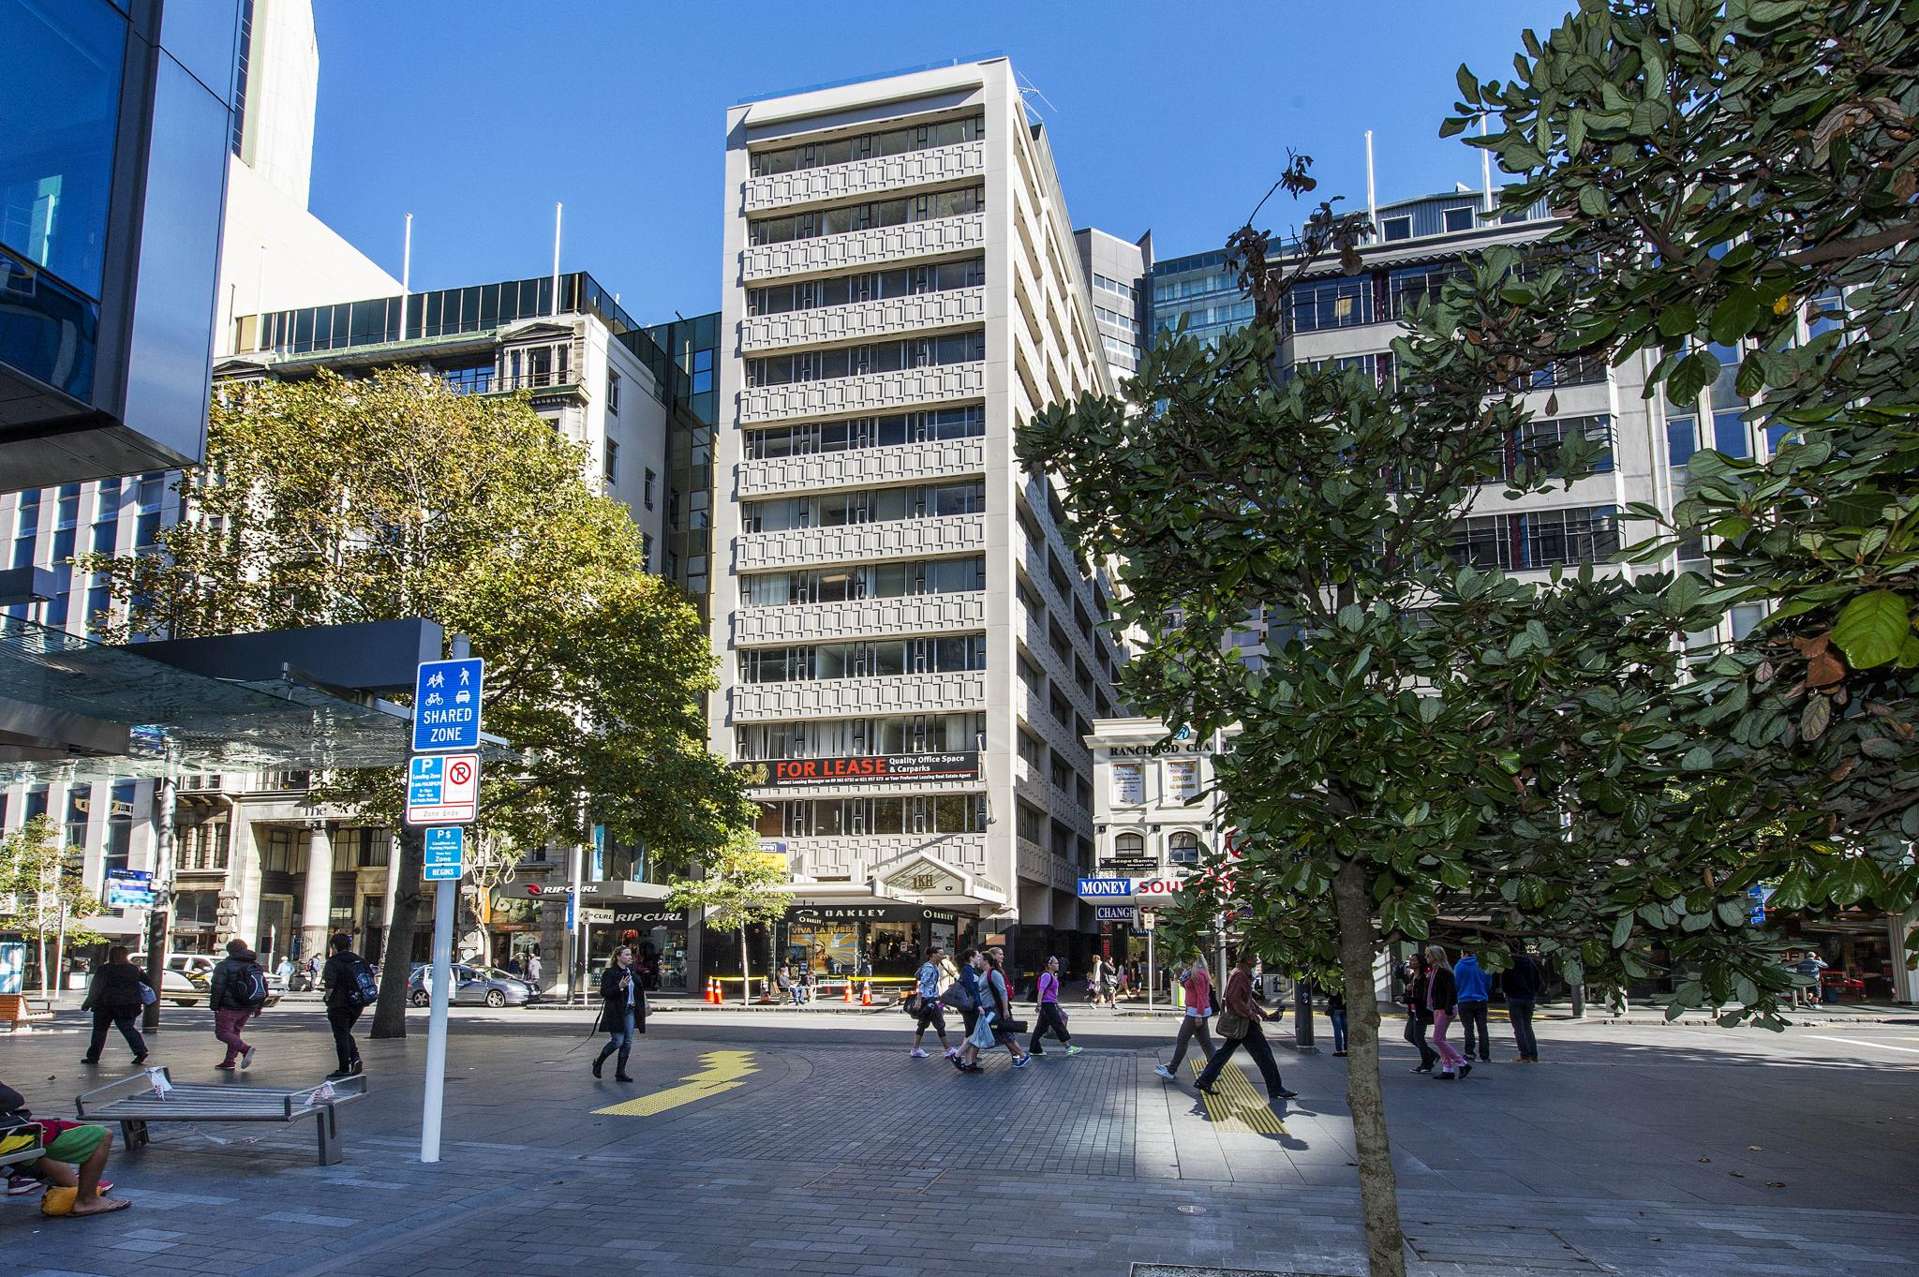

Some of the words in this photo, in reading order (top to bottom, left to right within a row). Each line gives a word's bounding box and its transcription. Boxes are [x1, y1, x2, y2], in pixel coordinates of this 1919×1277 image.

[423, 707, 472, 725] SHARED
[430, 727, 462, 742] ZONE
[421, 758, 433, 773] P
[889, 757, 917, 766] Quality
[918, 756, 941, 764] Office
[942, 755, 964, 764] Space
[776, 761, 816, 778] FOR
[823, 758, 886, 776] LEASE
[897, 765, 931, 774] Carparks
[305, 806, 327, 816] The
[543, 886, 564, 894] RIP
[565, 885, 599, 893] CRL
[1081, 881, 1127, 895] MONEY
[616, 913, 643, 922] RIP
[643, 912, 683, 921] CURL
[825, 909, 885, 917] OAKLEY
